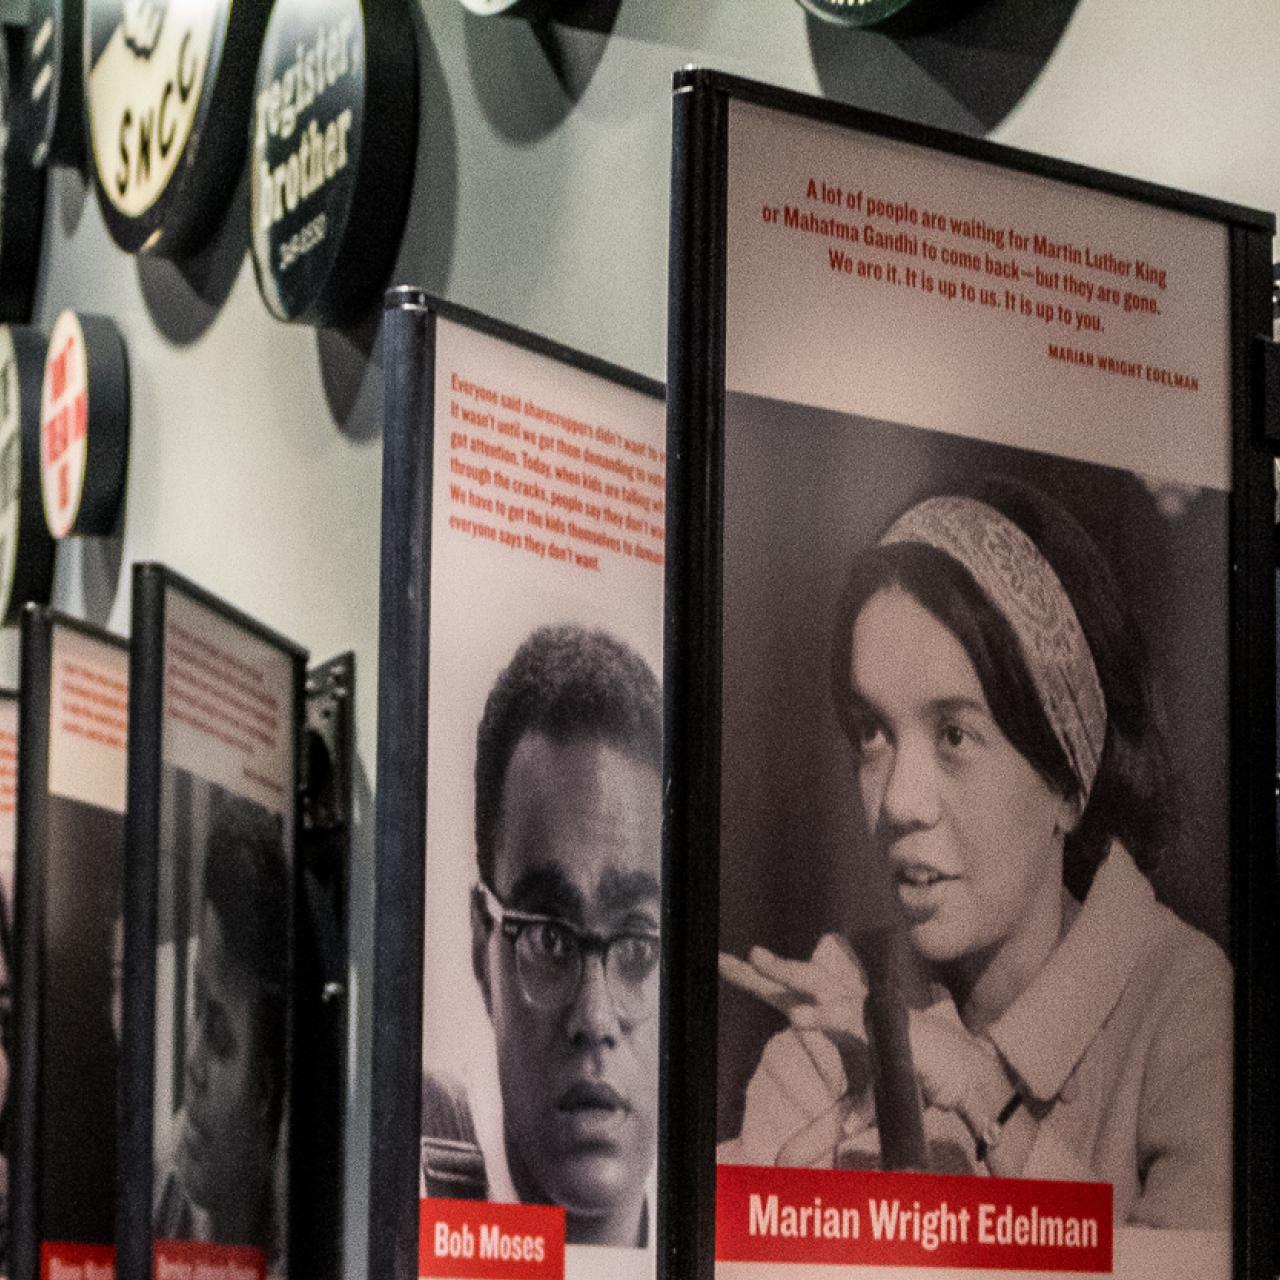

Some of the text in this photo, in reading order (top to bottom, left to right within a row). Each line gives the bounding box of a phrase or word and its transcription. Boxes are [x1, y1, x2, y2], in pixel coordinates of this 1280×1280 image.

[117, 31, 200, 195] SNCC
[806, 178, 1167, 290] A lot of people are waiting for Martin Luther King
[1049, 345, 1198, 390] MARIAN WRIGHT EDELMAN
[434, 1222, 544, 1262] Bob Moses
[749, 1194, 1098, 1251] Marian Wright Edelman
